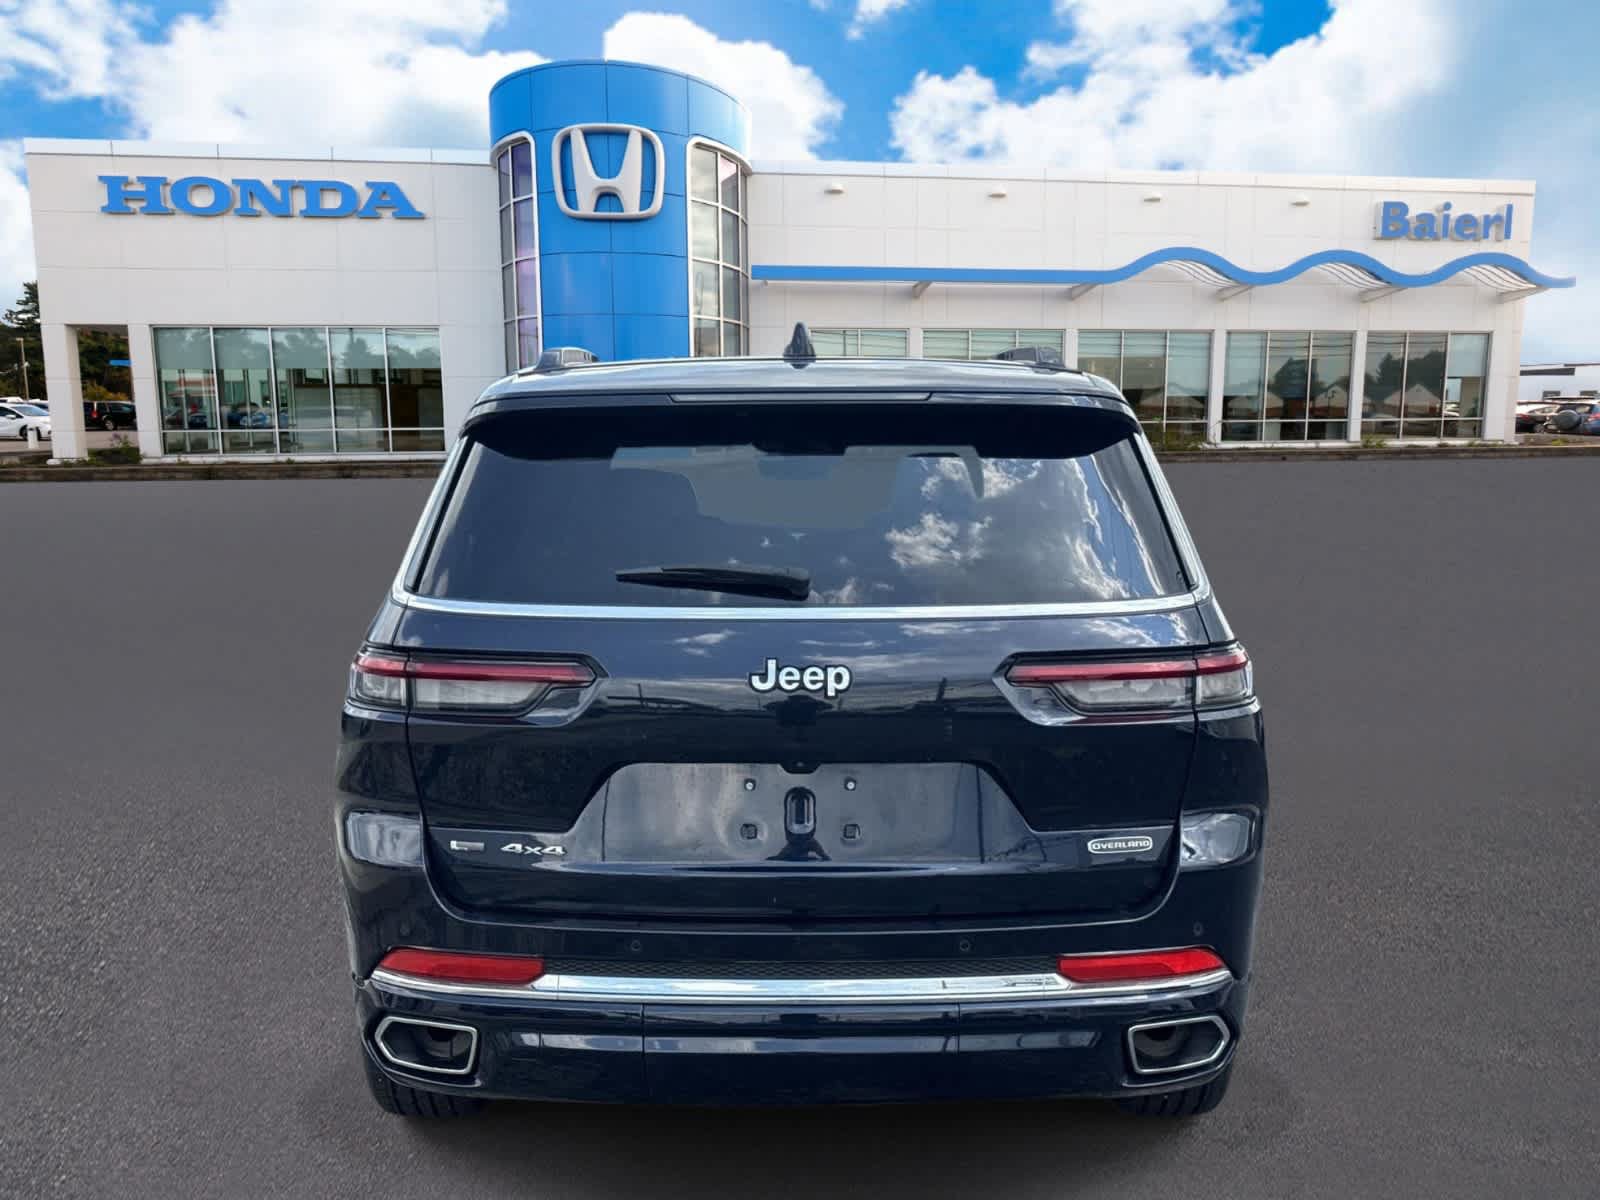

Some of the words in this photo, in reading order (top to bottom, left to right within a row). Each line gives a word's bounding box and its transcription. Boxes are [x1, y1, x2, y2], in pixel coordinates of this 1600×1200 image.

[98, 174, 425, 218] HONDA
[1378, 200, 1514, 241] Baierl
[750, 658, 851, 698] Jeep
[500, 843, 567, 856] 4x4
[1092, 839, 1150, 851] OVERLAND
